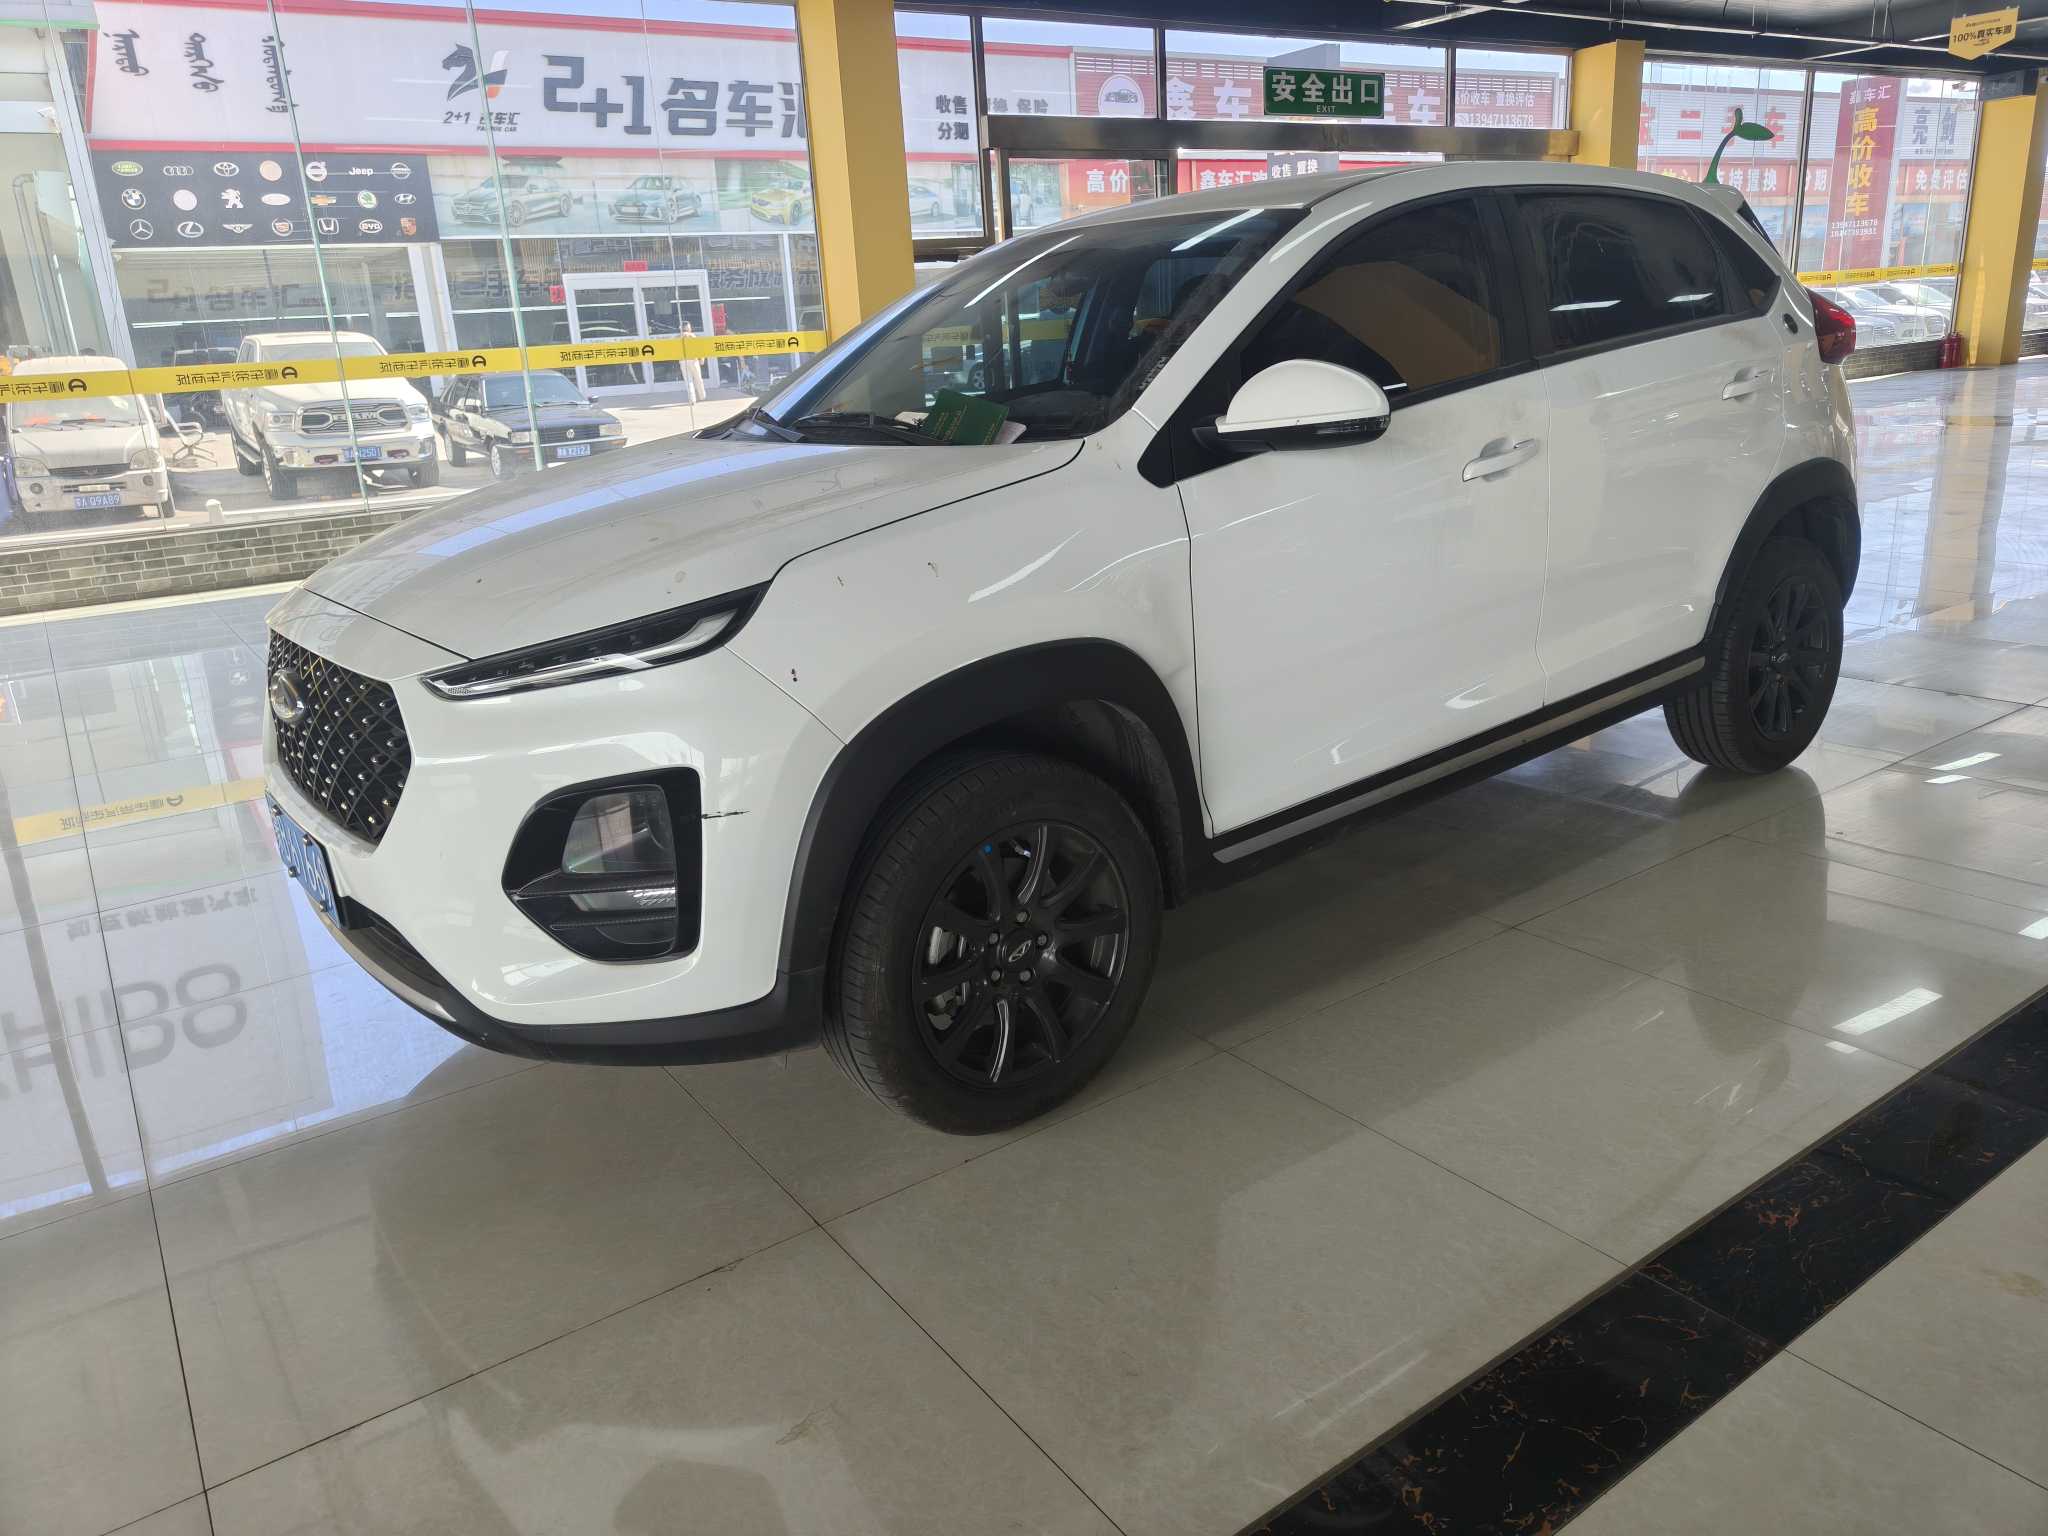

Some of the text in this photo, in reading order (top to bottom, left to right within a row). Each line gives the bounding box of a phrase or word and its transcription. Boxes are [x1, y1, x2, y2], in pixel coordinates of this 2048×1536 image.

[1271, 71, 1379, 105] 安全出口
[935, 94, 968, 115] 收售
[1016, 97, 1049, 114] 保险
[1456, 90, 1490, 107] 价收车
[443, 110, 471, 125] 2+1
[1316, 104, 1337, 113] EXIT
[1296, 158, 1318, 176] 置换
[1846, 106, 1879, 217] 高价收车
[348, 166, 374, 177] Jeep
[1086, 168, 1129, 193] 高价
[1915, 168, 1968, 192] 免费评估
